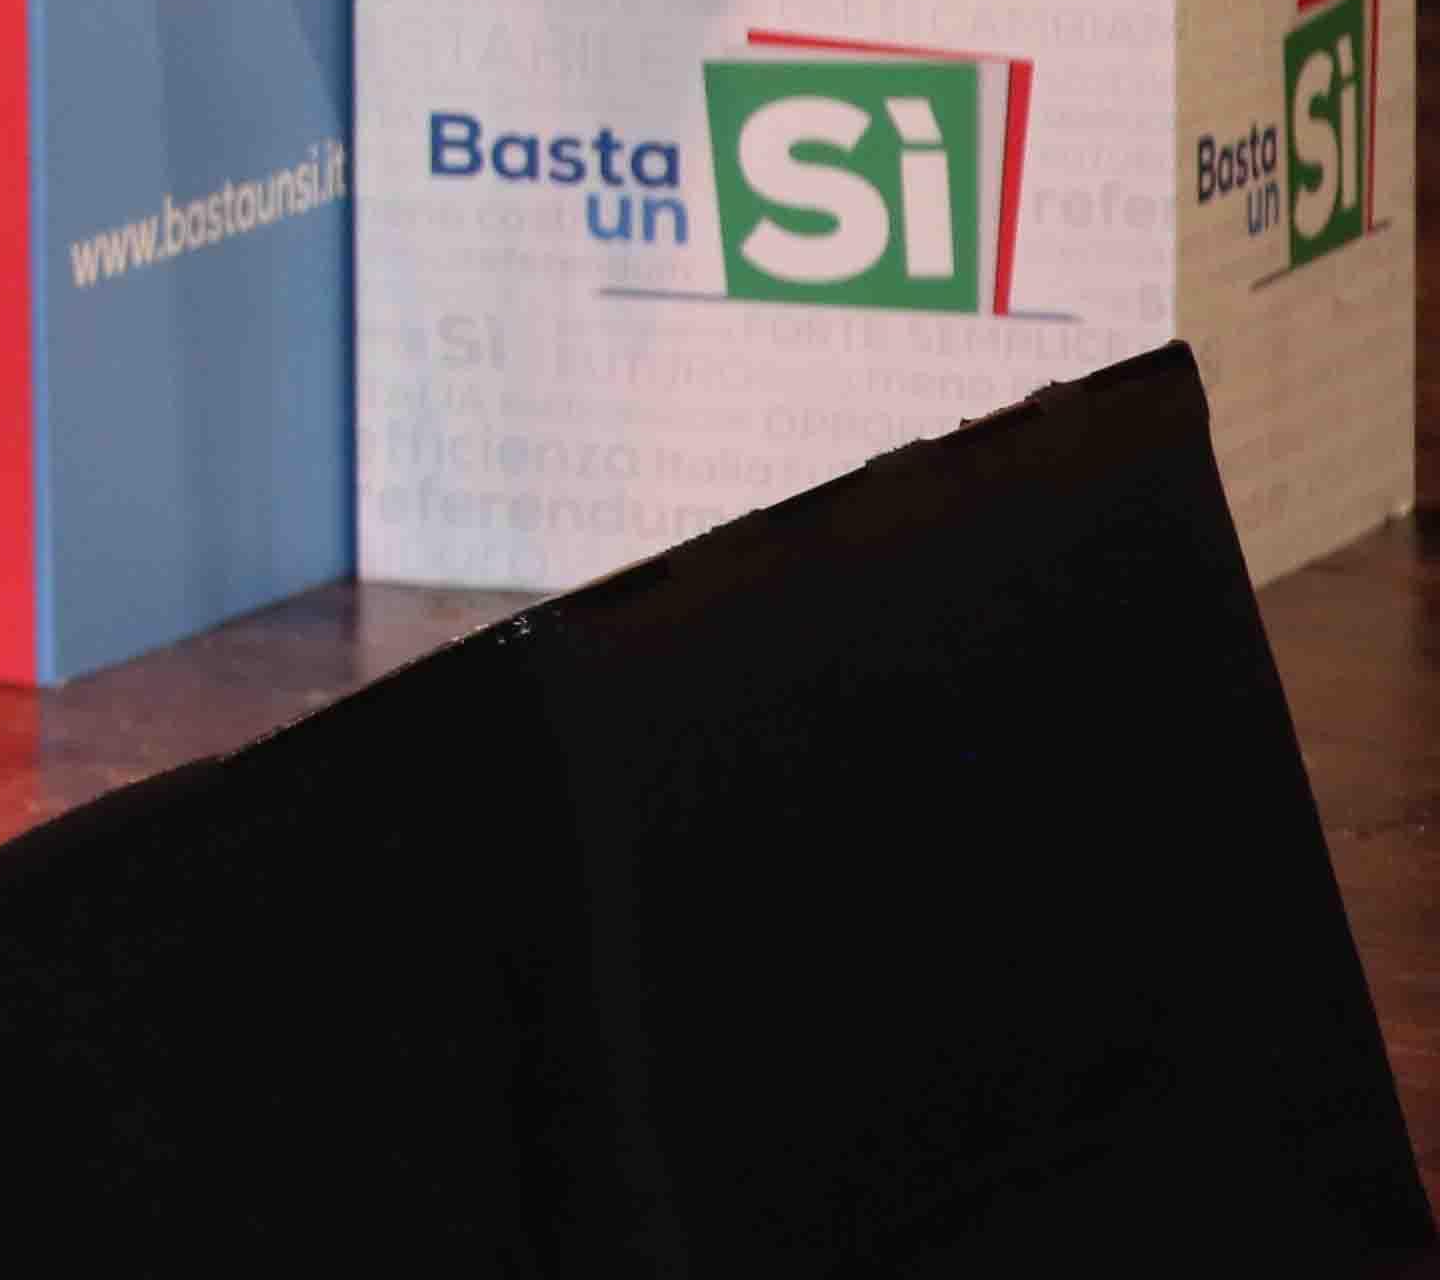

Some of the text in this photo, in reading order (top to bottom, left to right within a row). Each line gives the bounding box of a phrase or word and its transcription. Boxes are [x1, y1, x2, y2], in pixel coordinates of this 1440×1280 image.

[427, 106, 680, 190] Basta
[1197, 121, 1278, 206] Basta
[1292, 33, 1358, 240] Sì
[68, 137, 346, 288] www.bastaunsi.it
[585, 192, 691, 247] un
[736, 93, 956, 284] Sì
[1247, 180, 1280, 238] un
